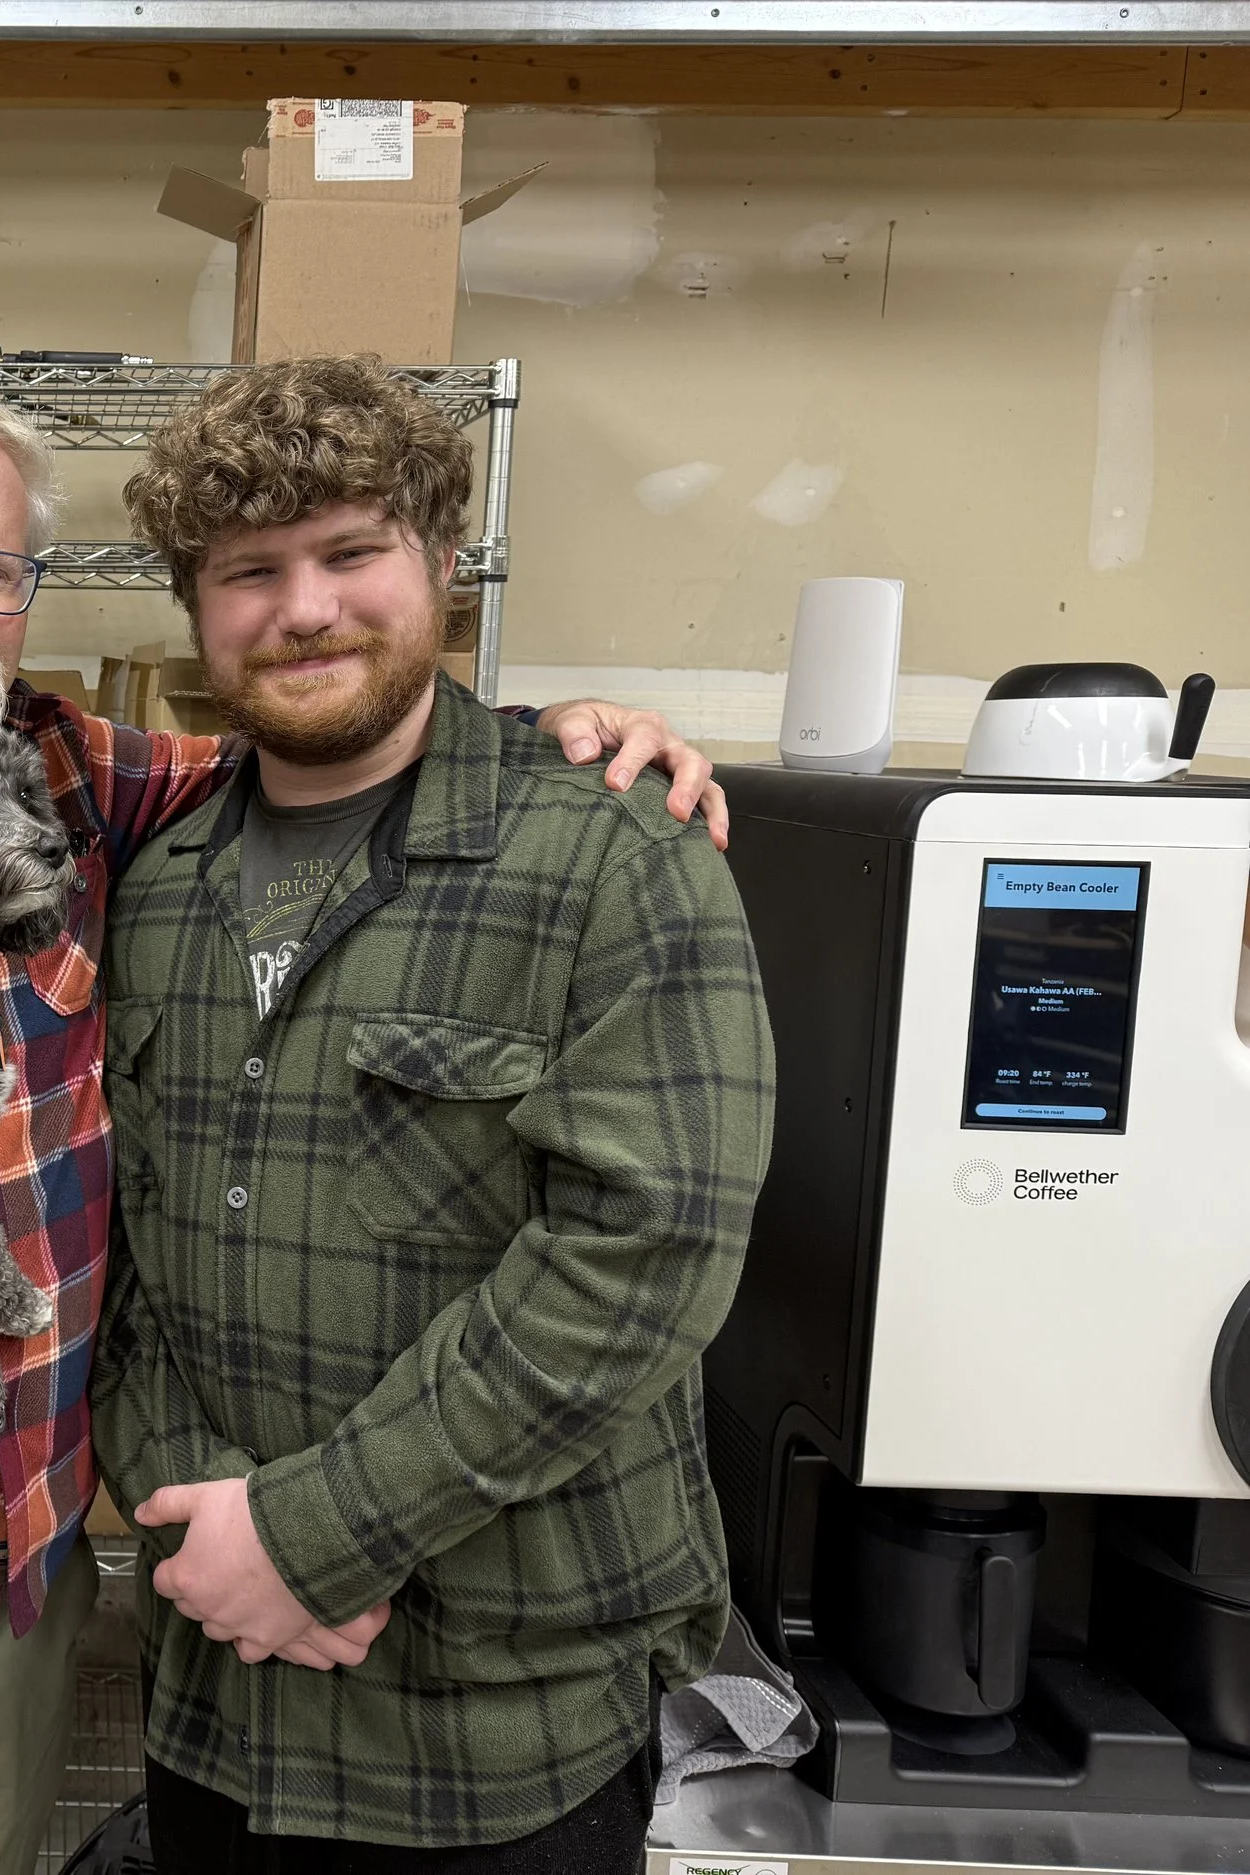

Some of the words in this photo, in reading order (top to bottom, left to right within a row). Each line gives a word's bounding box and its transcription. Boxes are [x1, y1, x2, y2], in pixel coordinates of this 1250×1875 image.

[799, 726, 821, 741] orbi
[1005, 881, 1044, 894] Empty
[1046, 881, 1076, 892] Bean
[1078, 882, 1119, 893] Cooler
[1001, 985, 1028, 994] Usawa
[1029, 986, 1061, 995] Kahawa
[1062, 987, 1075, 995] AA
[997, 1069, 1020, 1077] 09:20
[1065, 1071, 1081, 1079] 334
[1014, 1168, 1119, 1185] Bellwether
[1013, 1185, 1079, 1201] Coffee
[686, 1866, 742, 1875] REGENCY
